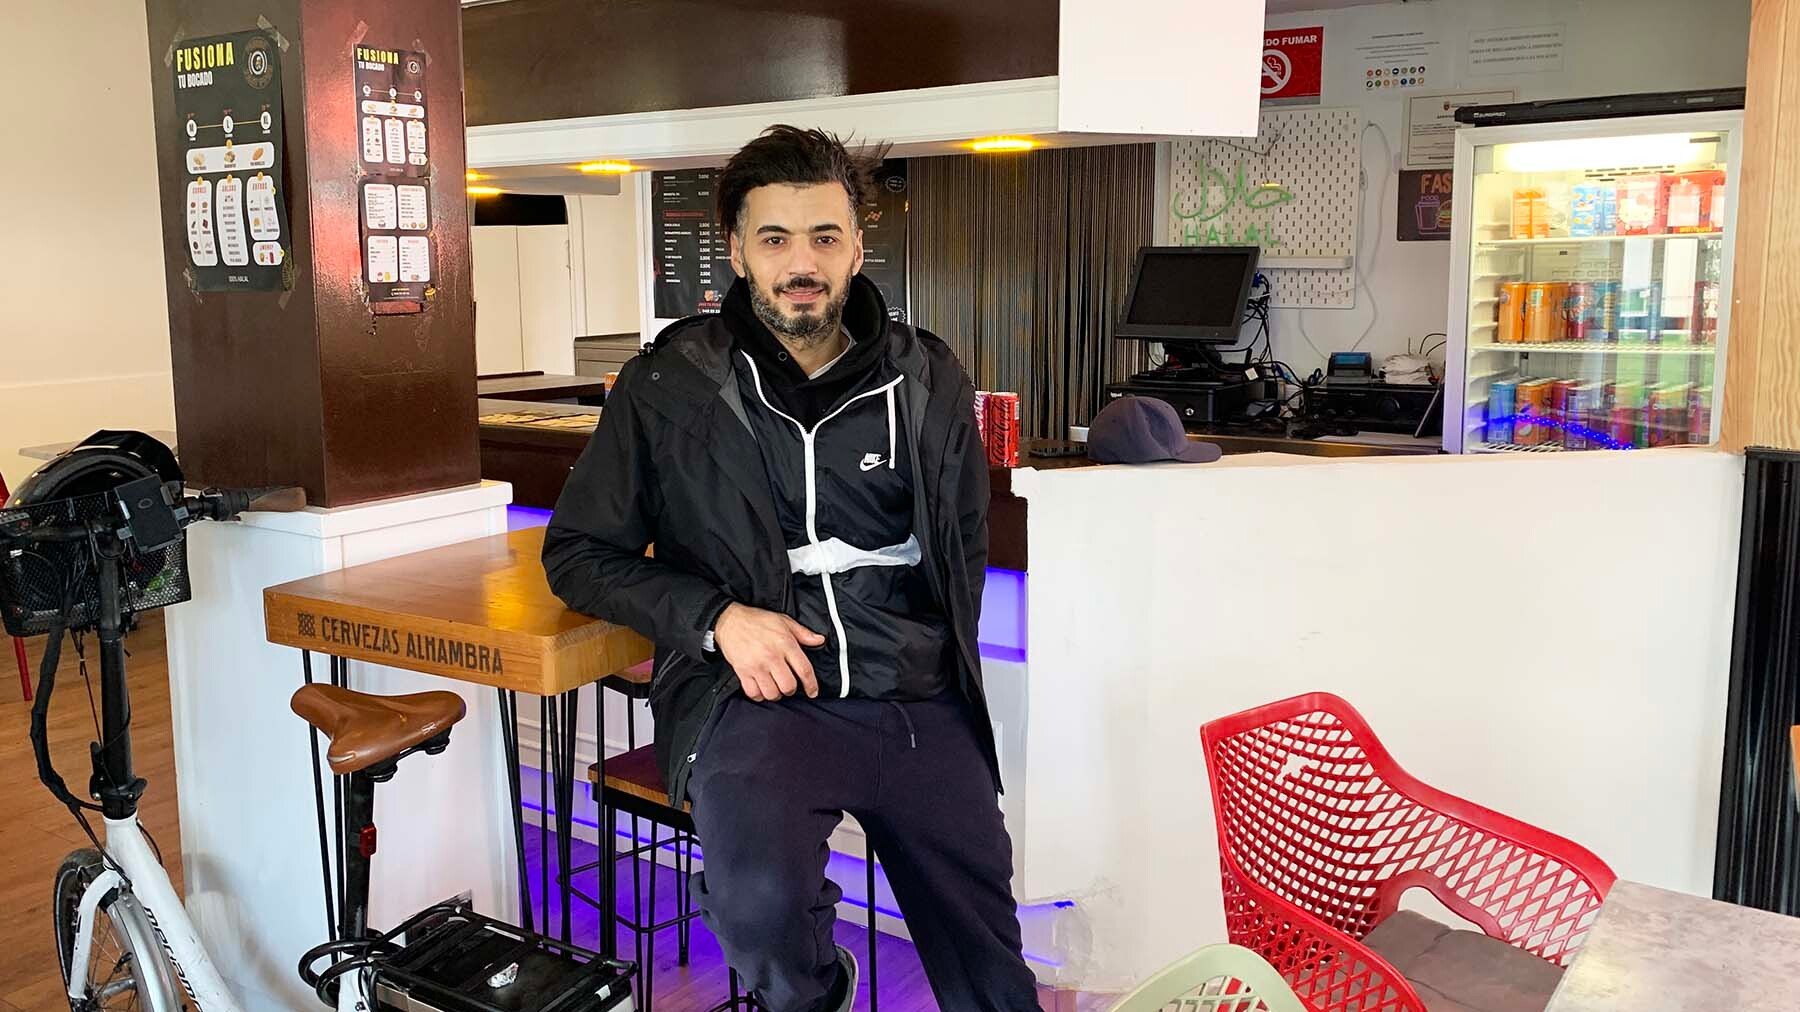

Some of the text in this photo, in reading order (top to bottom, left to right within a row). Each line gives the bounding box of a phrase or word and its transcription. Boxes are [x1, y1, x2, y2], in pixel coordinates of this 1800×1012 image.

[1264, 35, 1317, 46] DO FUMAR
[177, 42, 234, 72] FUSIONA
[357, 48, 399, 64] FUSIONA
[178, 71, 212, 88] TU BOCADO
[1420, 172, 1452, 194] FAS
[1184, 222, 1282, 246] HALAL
[864, 453, 881, 463] NIKE
[322, 616, 503, 675] CERVEZAS ALHAMBRA
